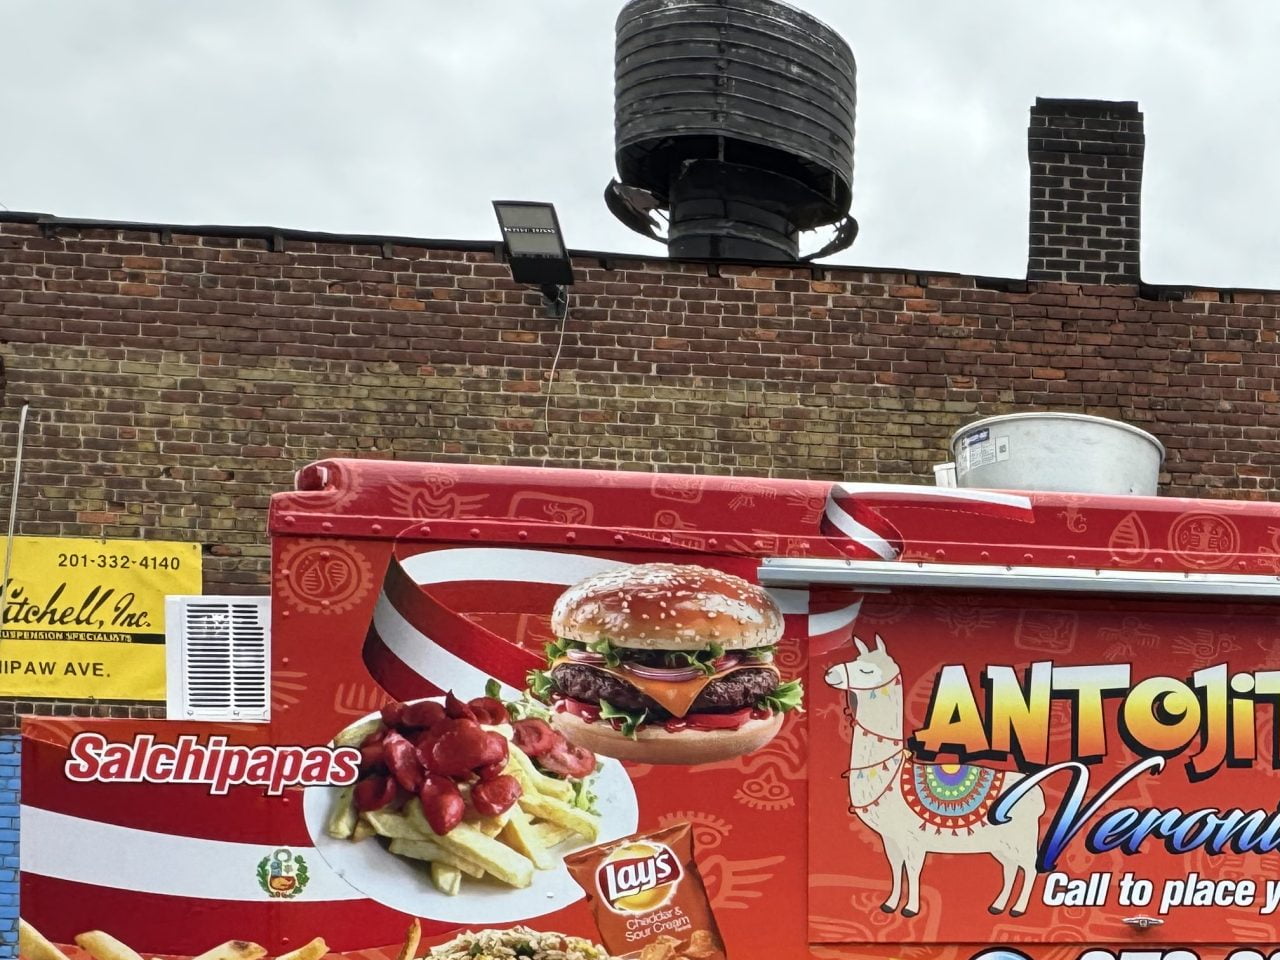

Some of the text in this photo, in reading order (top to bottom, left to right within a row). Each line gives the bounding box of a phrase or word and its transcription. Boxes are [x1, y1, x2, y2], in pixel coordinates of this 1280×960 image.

[58, 553, 181, 571] 201-332-4140
[0, 579, 151, 629] itchell, Inc.
[0, 630, 132, 643] USPENSION SPECIALISTS
[0, 661, 111, 677] IPAW AVE.
[65, 733, 362, 795] Salchipapas
[605, 851, 671, 900] Lay's
[1043, 871, 1114, 907] Call
[1120, 874, 1151, 907] to
[1161, 874, 1256, 914] place
[625, 928, 652, 942] Sour
[653, 916, 690, 933] Cream
[626, 909, 673, 930] Cheddar
